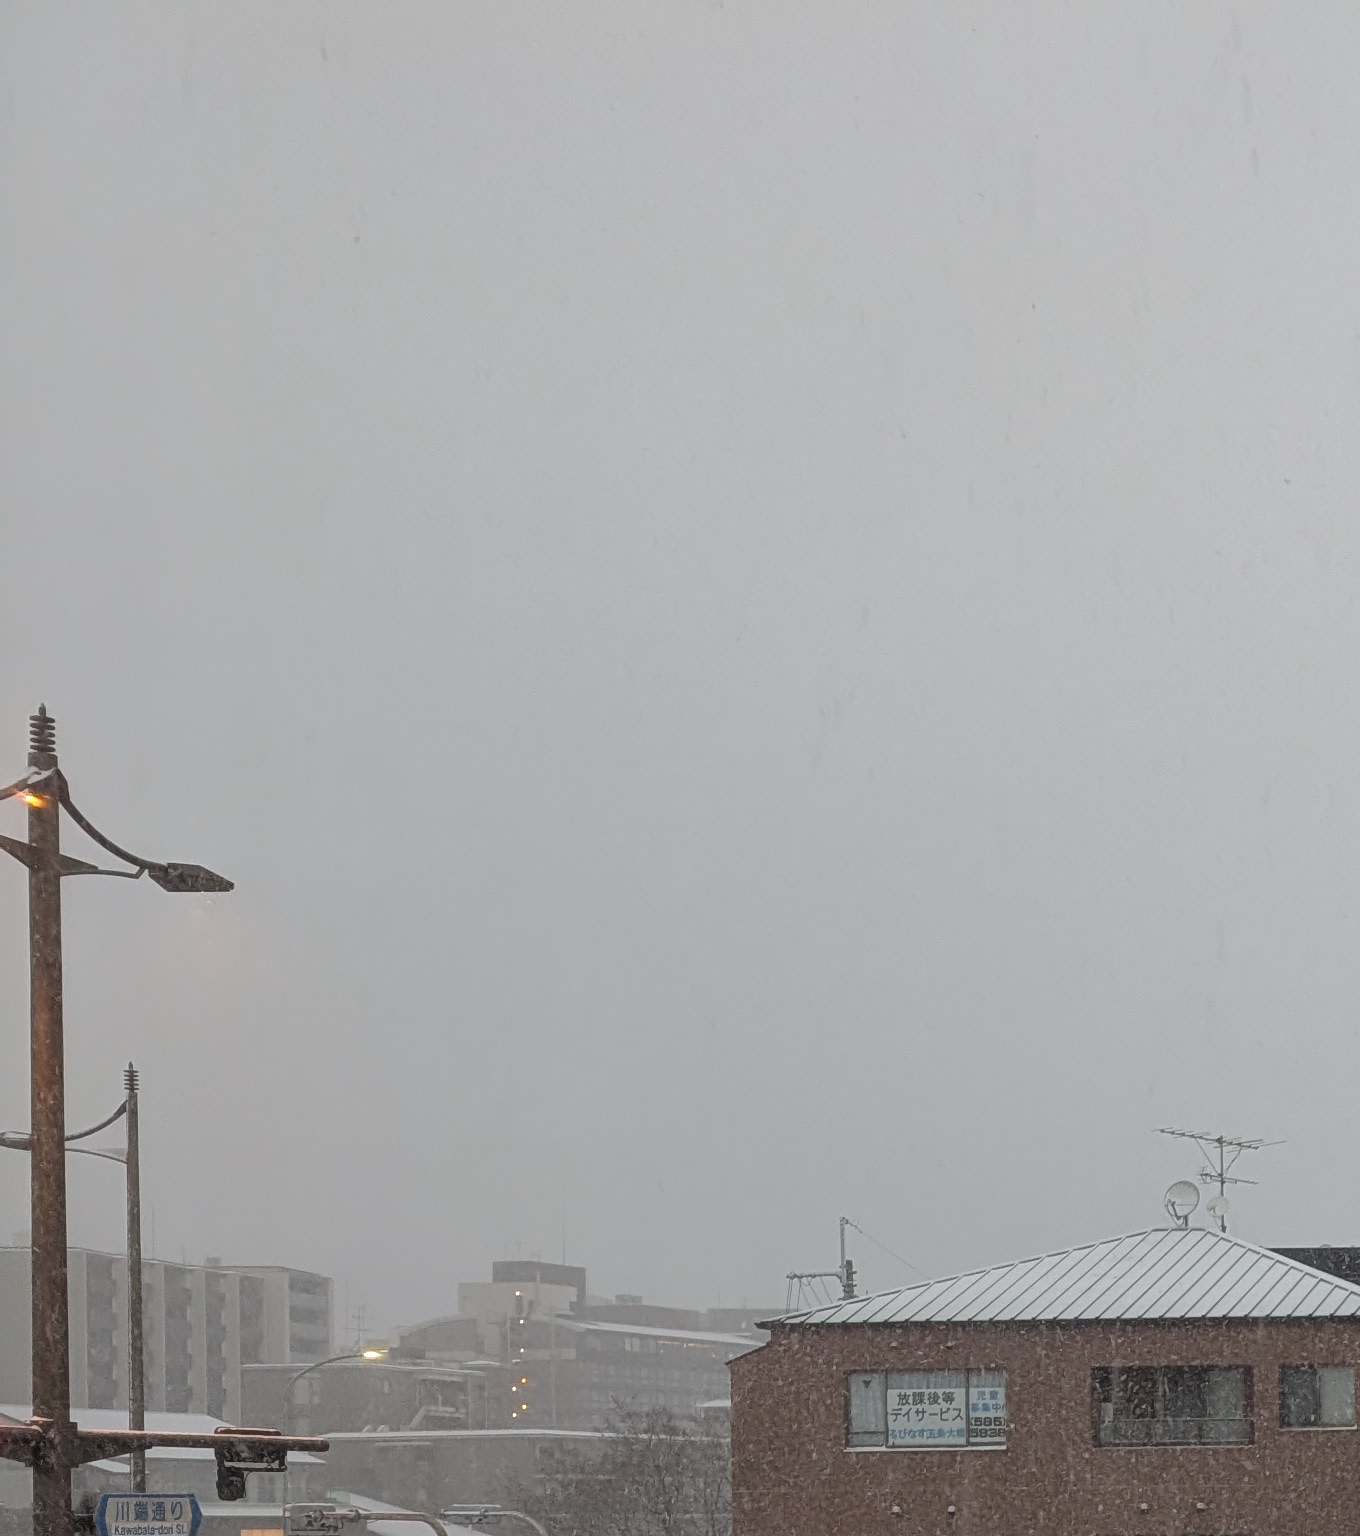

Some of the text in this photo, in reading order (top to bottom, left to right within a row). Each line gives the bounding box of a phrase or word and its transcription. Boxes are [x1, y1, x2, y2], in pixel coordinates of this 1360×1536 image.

[897, 1391, 956, 1406] 放課後等
[889, 1407, 964, 1422] デイサービス
[115, 1501, 183, 1521] 川端通り
